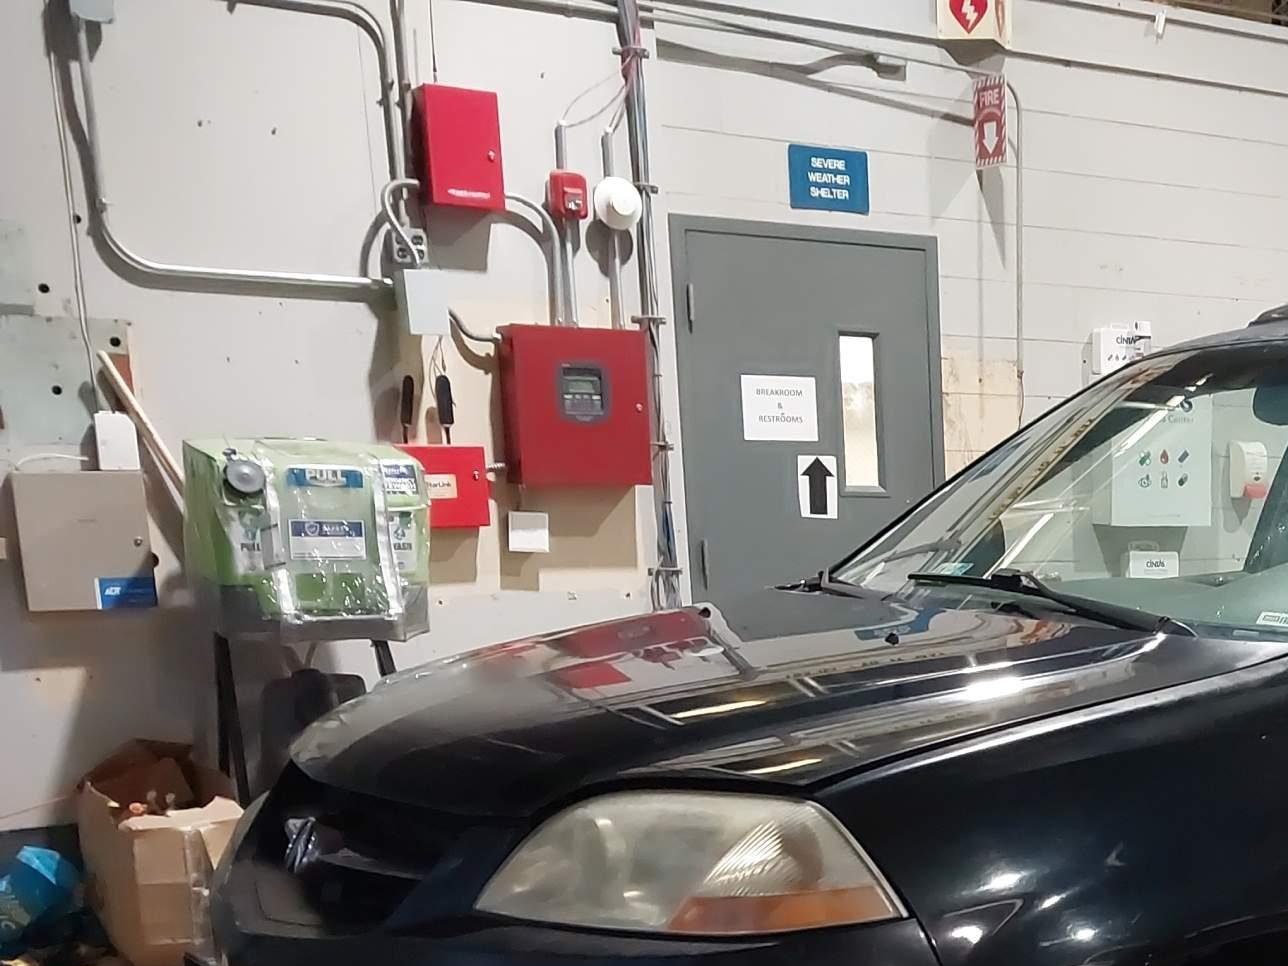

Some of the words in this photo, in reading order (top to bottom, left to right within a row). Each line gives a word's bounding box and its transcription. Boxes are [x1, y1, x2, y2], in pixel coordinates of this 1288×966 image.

[980, 88, 1000, 108] FIRE
[811, 157, 846, 171] SEVERE
[808, 171, 850, 186] WEATHER
[810, 186, 849, 200] SHELTER
[756, 388, 803, 397] BREAKROOM
[759, 414, 803, 424] RESTROOMS
[305, 469, 347, 481] PULL
